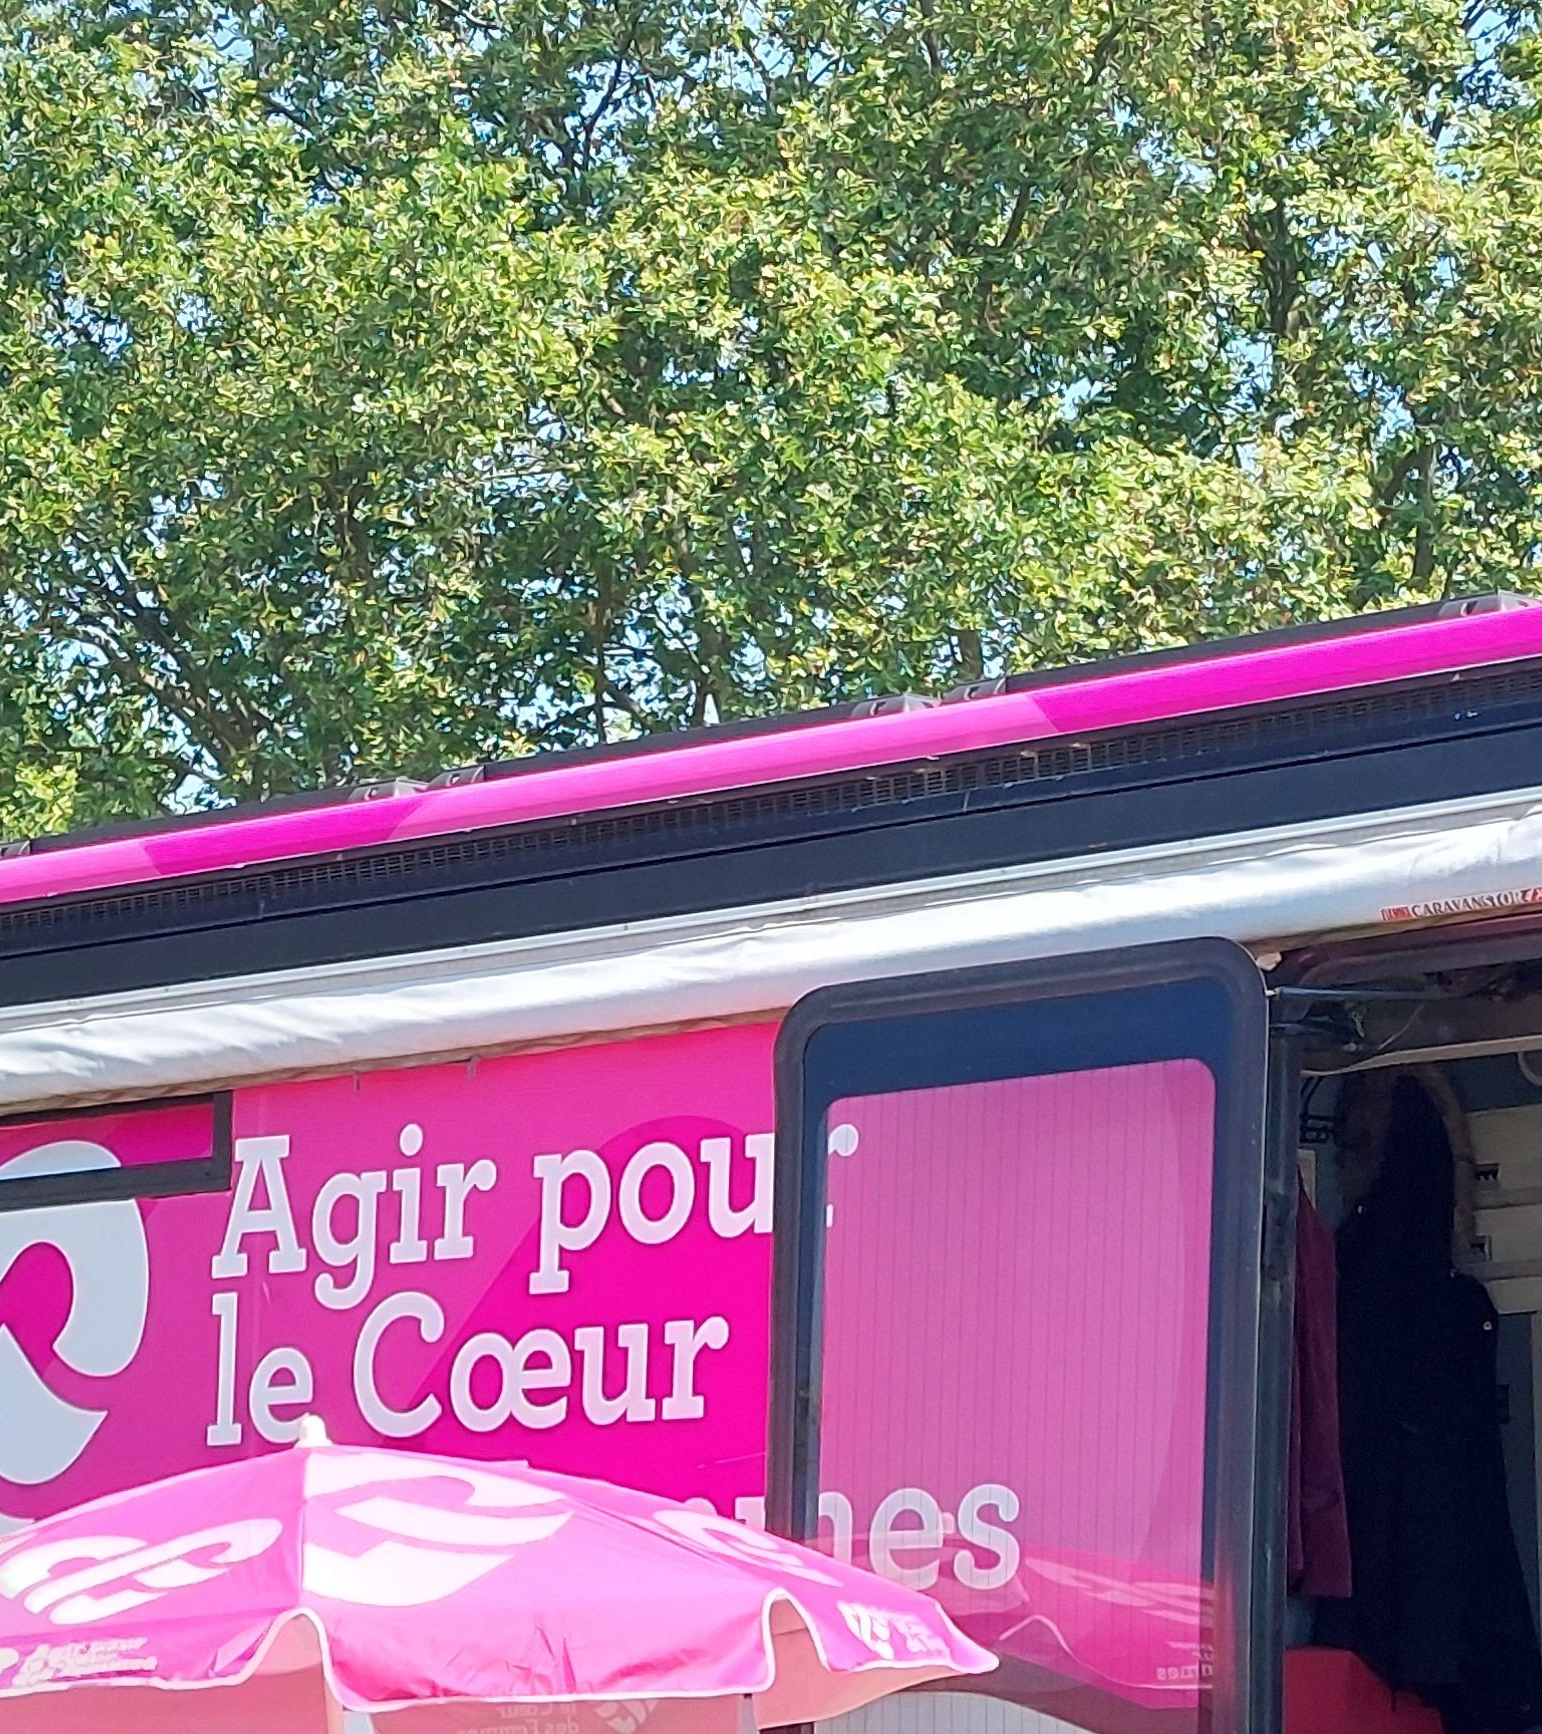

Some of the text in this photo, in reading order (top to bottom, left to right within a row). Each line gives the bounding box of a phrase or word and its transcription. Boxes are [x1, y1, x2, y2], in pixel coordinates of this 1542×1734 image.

[209, 1122, 497, 1311] Agir
[206, 1290, 729, 1447] le Cœur
